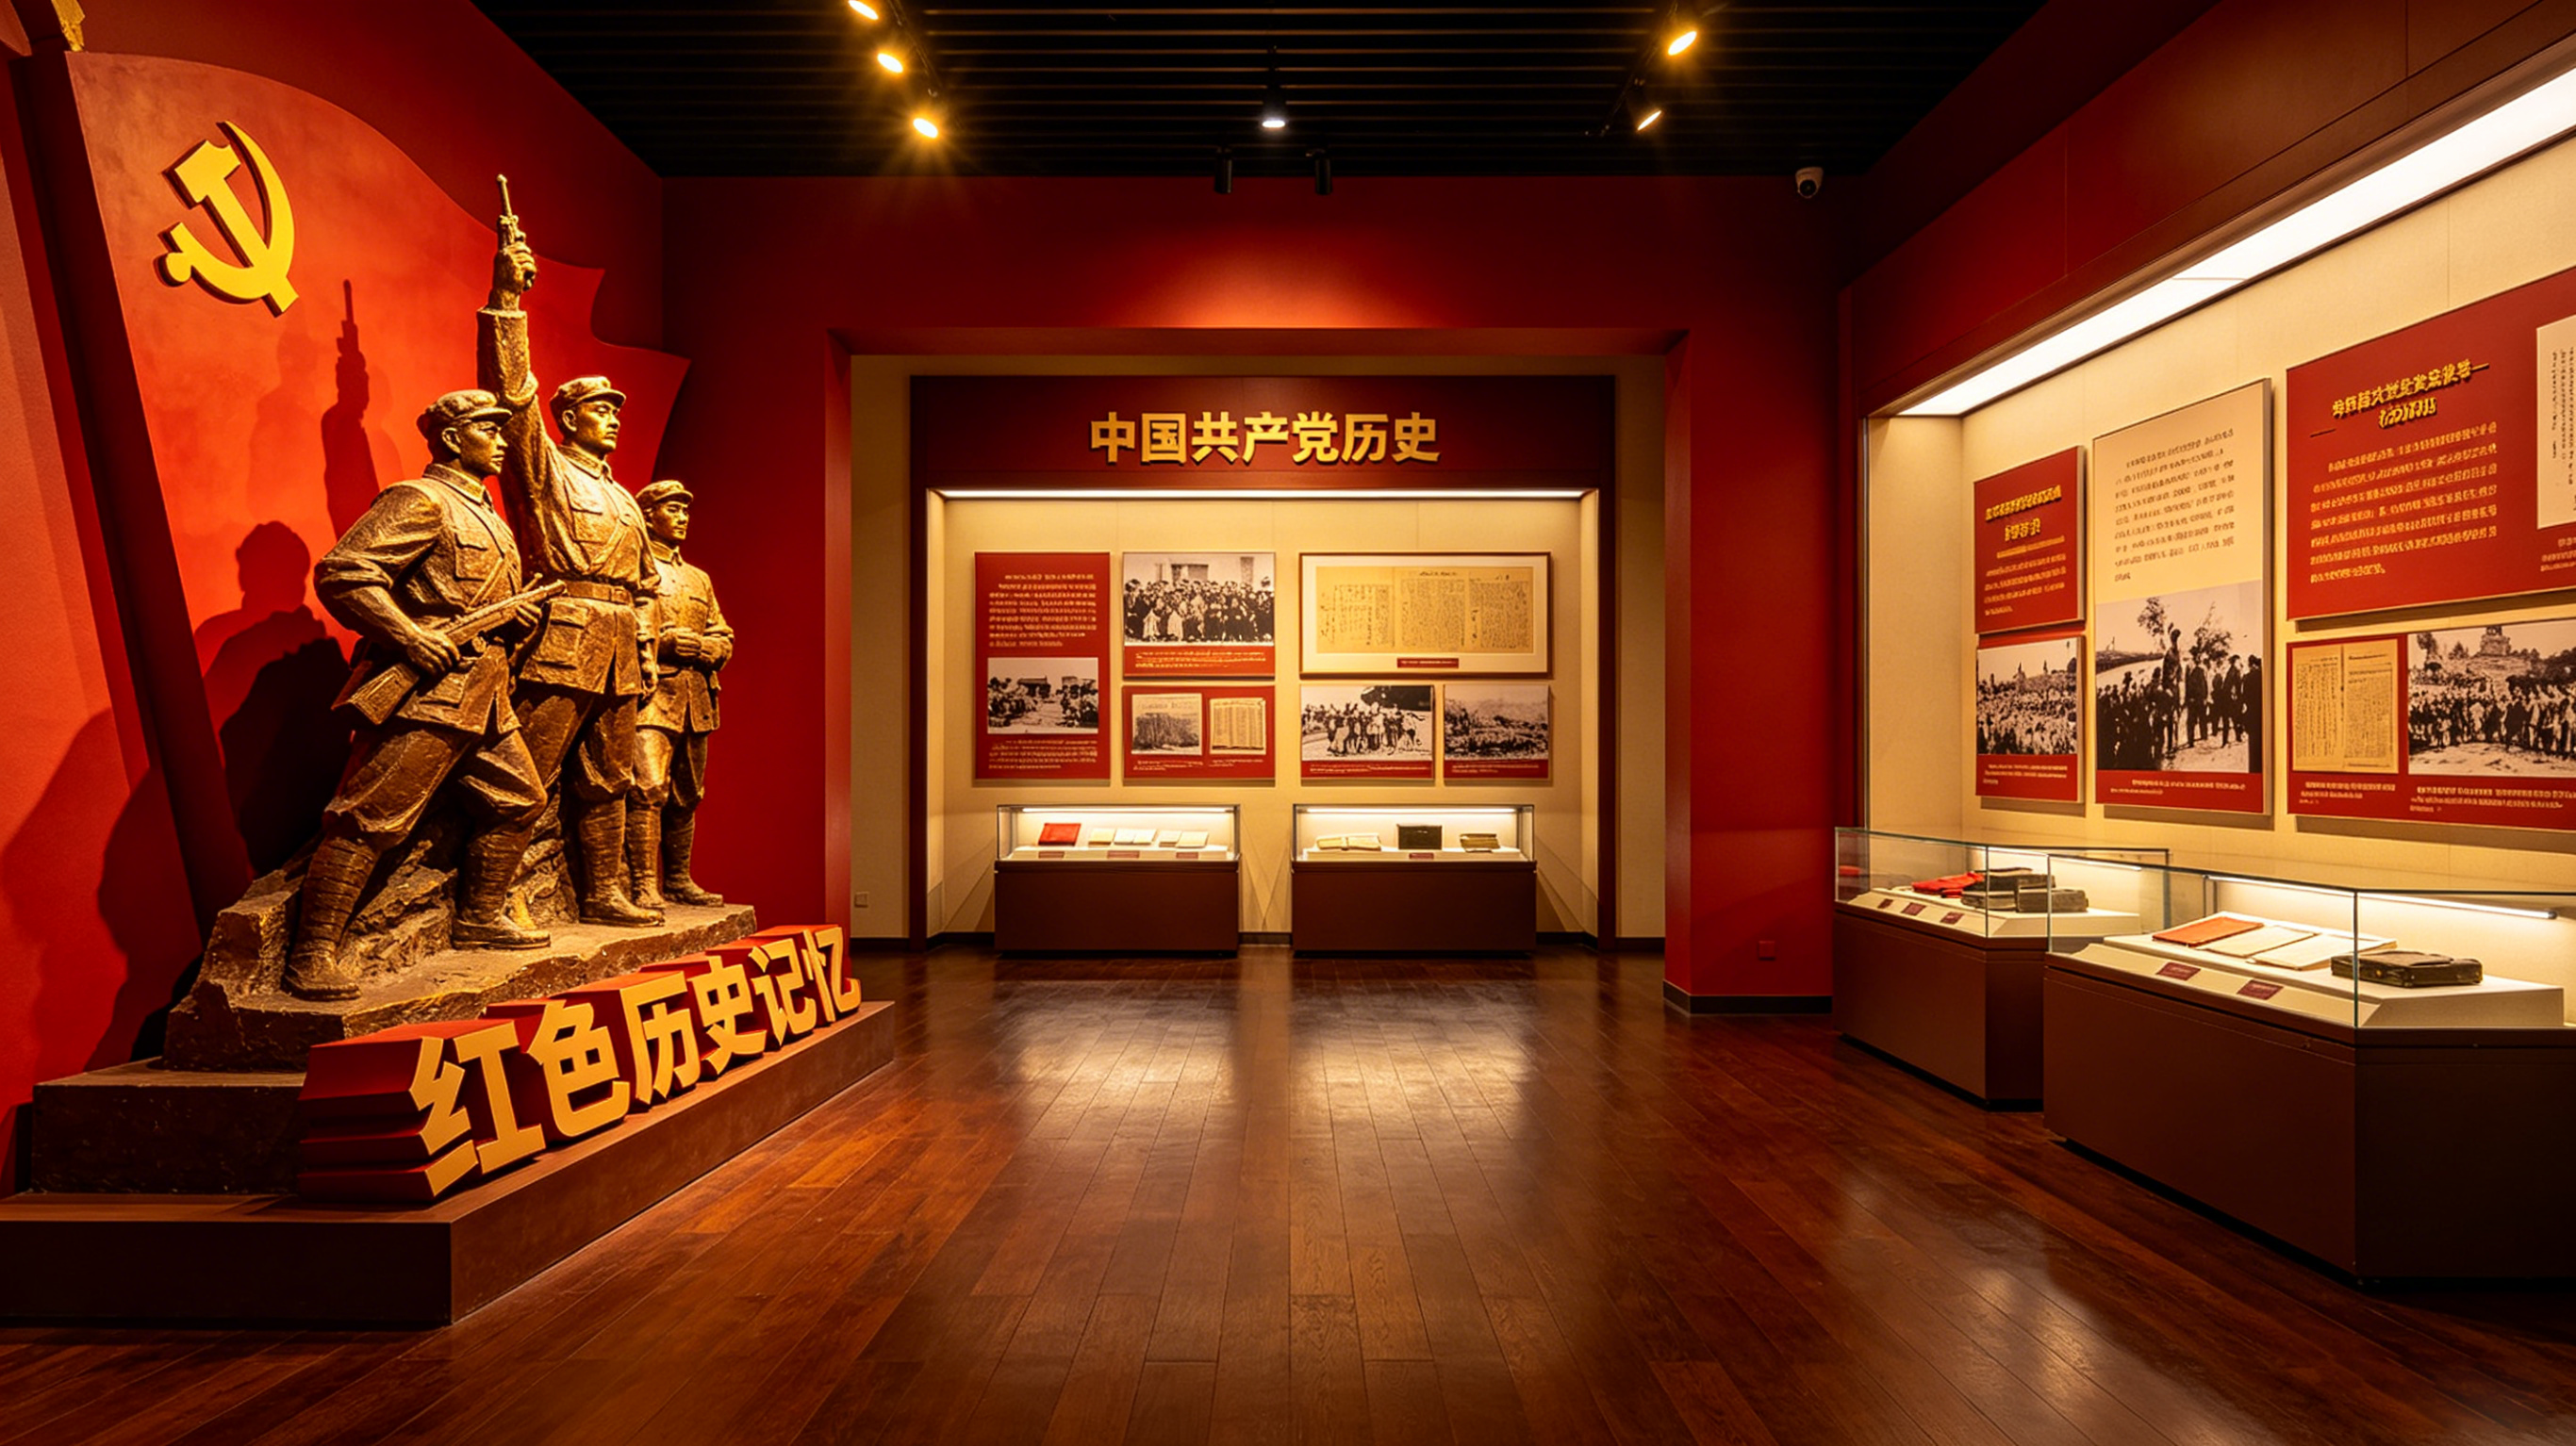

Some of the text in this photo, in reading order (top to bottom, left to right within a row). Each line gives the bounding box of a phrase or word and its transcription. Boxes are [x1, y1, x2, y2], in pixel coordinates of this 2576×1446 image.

[1090, 411, 1441, 464] 中国共产党历史
[409, 926, 862, 1197] 红色历史记忆
